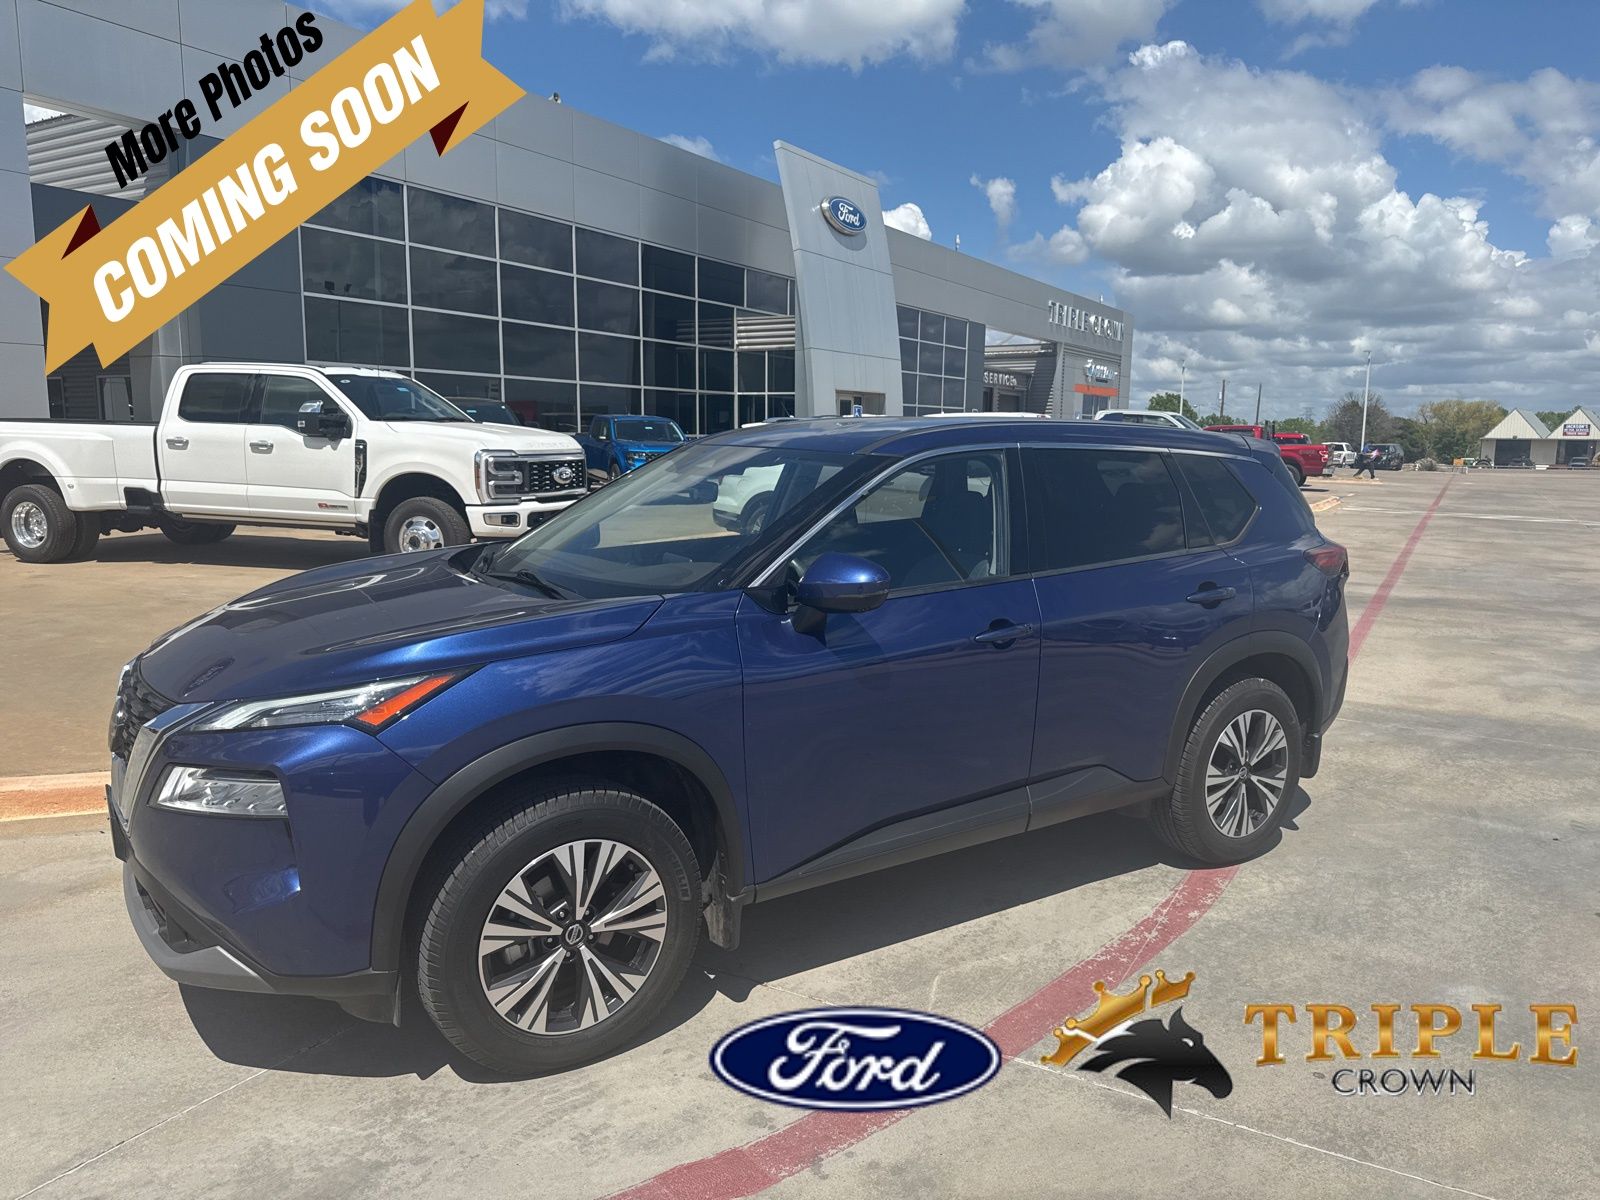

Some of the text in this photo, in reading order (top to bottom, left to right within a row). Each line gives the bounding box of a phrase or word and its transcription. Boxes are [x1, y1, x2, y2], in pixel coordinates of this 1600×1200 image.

[837, 202, 861, 227] Ford
[1048, 300, 1124, 341] TRIPLE CROWN
[983, 371, 1015, 387] SERVICE
